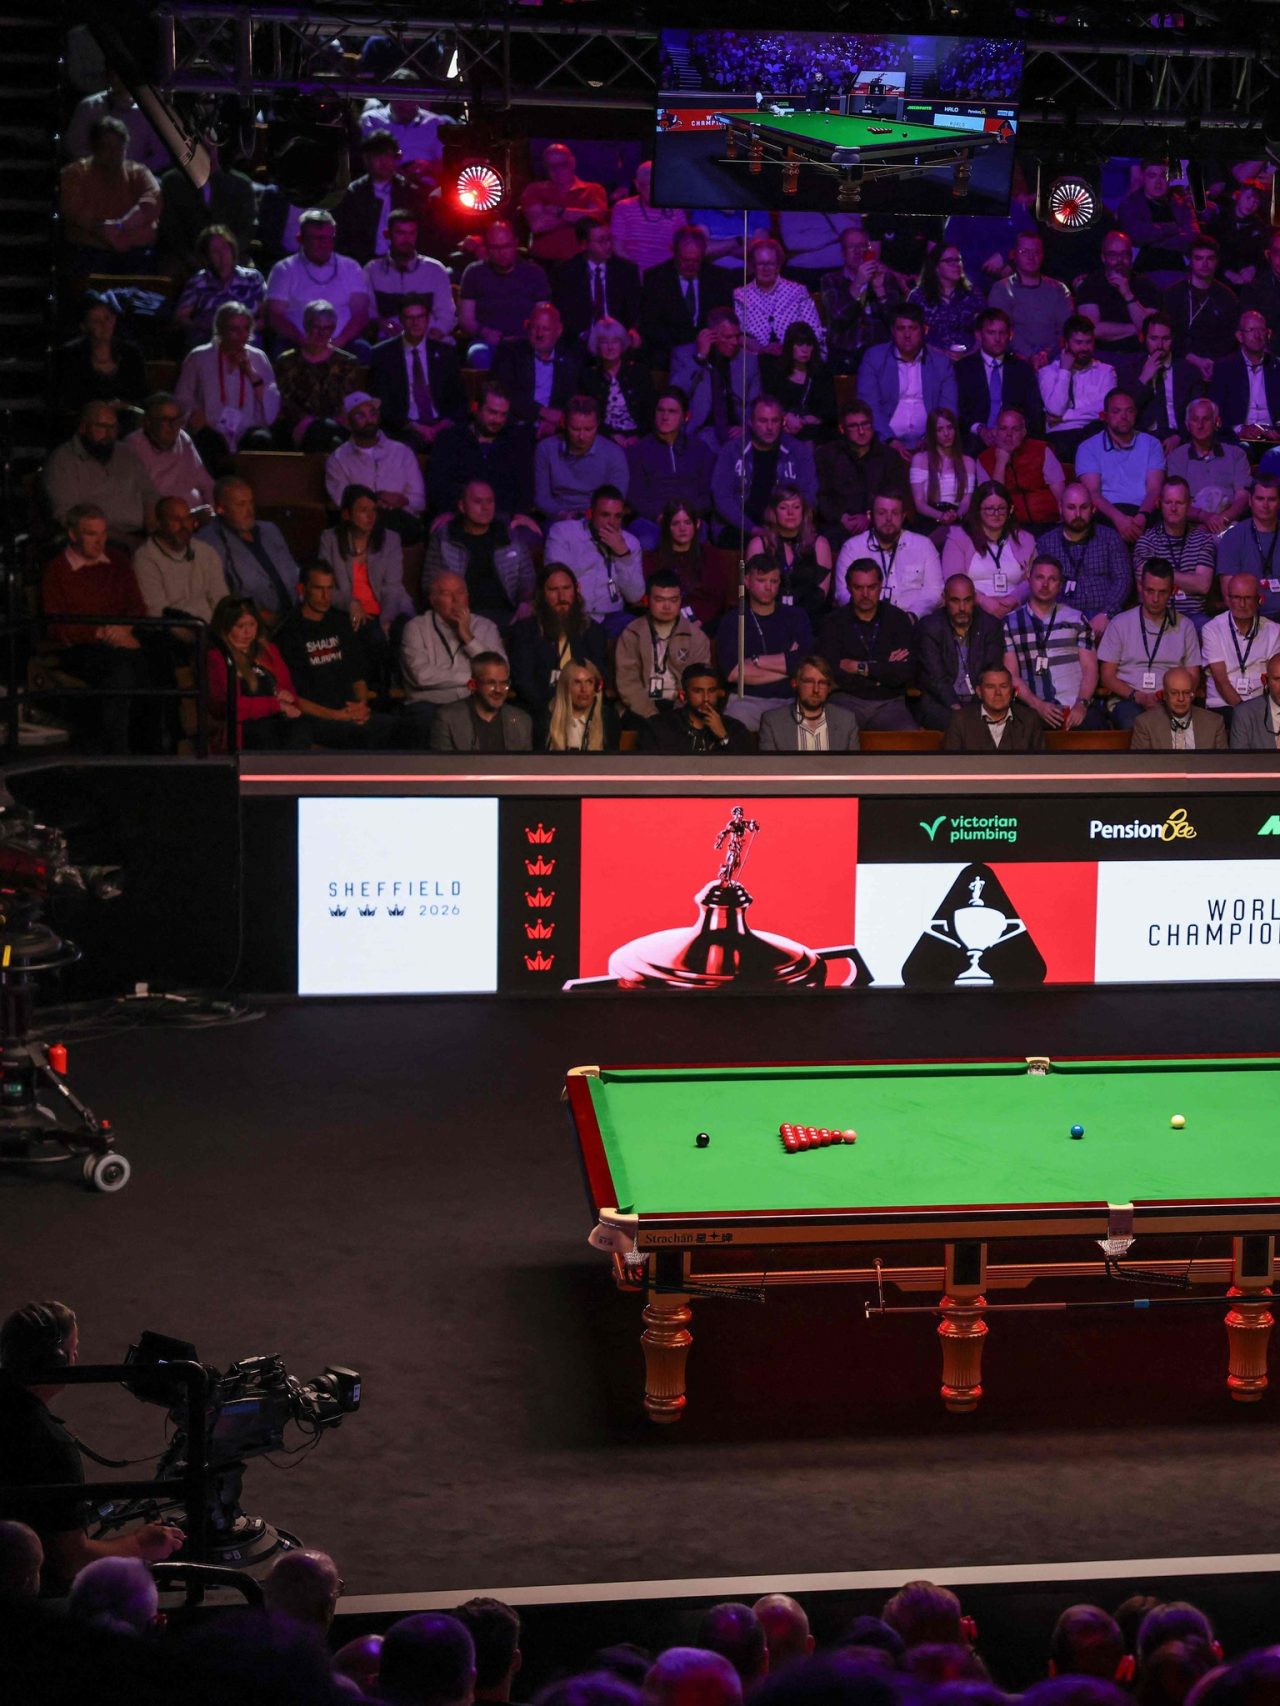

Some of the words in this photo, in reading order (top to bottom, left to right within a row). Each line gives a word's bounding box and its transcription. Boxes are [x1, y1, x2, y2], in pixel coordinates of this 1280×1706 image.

[306, 636, 340, 653] SHAUN
[950, 815, 1017, 828] victorian
[1090, 809, 1197, 841] PensionBee
[950, 827, 1017, 843] plumbing
[328, 880, 461, 897] SHEFFIELD
[419, 904, 460, 916] 2026
[646, 1232, 693, 1244] Strachan
